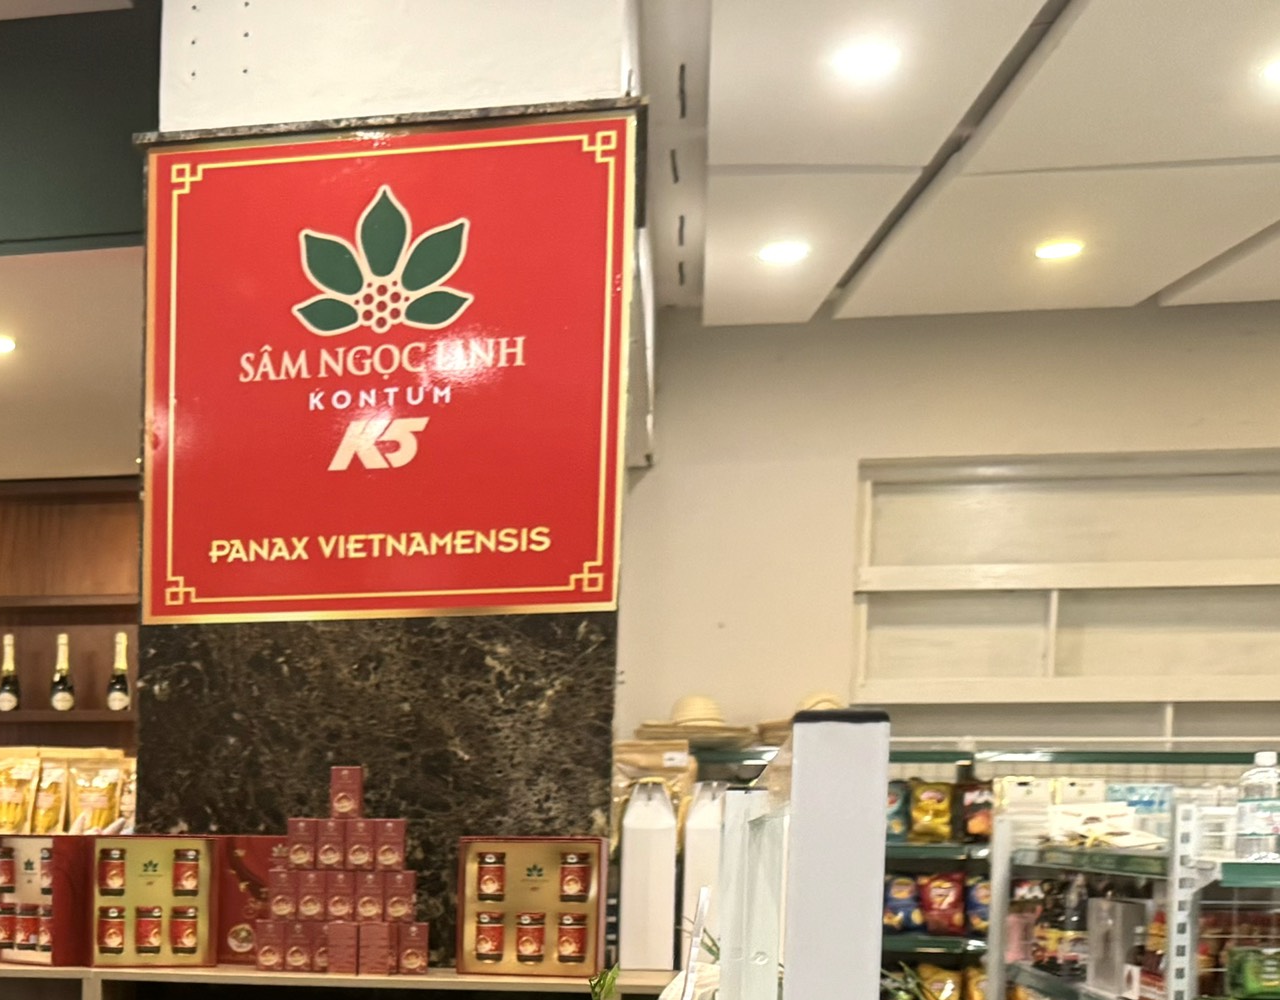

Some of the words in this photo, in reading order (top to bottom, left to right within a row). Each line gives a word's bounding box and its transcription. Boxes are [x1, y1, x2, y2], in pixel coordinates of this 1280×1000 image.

[238, 344, 311, 383] SÂM
[318, 341, 427, 380] NGỌC
[308, 385, 452, 411] KONTUM
[327, 416, 430, 471] K5
[208, 536, 310, 563] PANAX
[318, 526, 552, 560] VIETNAMENSIS
